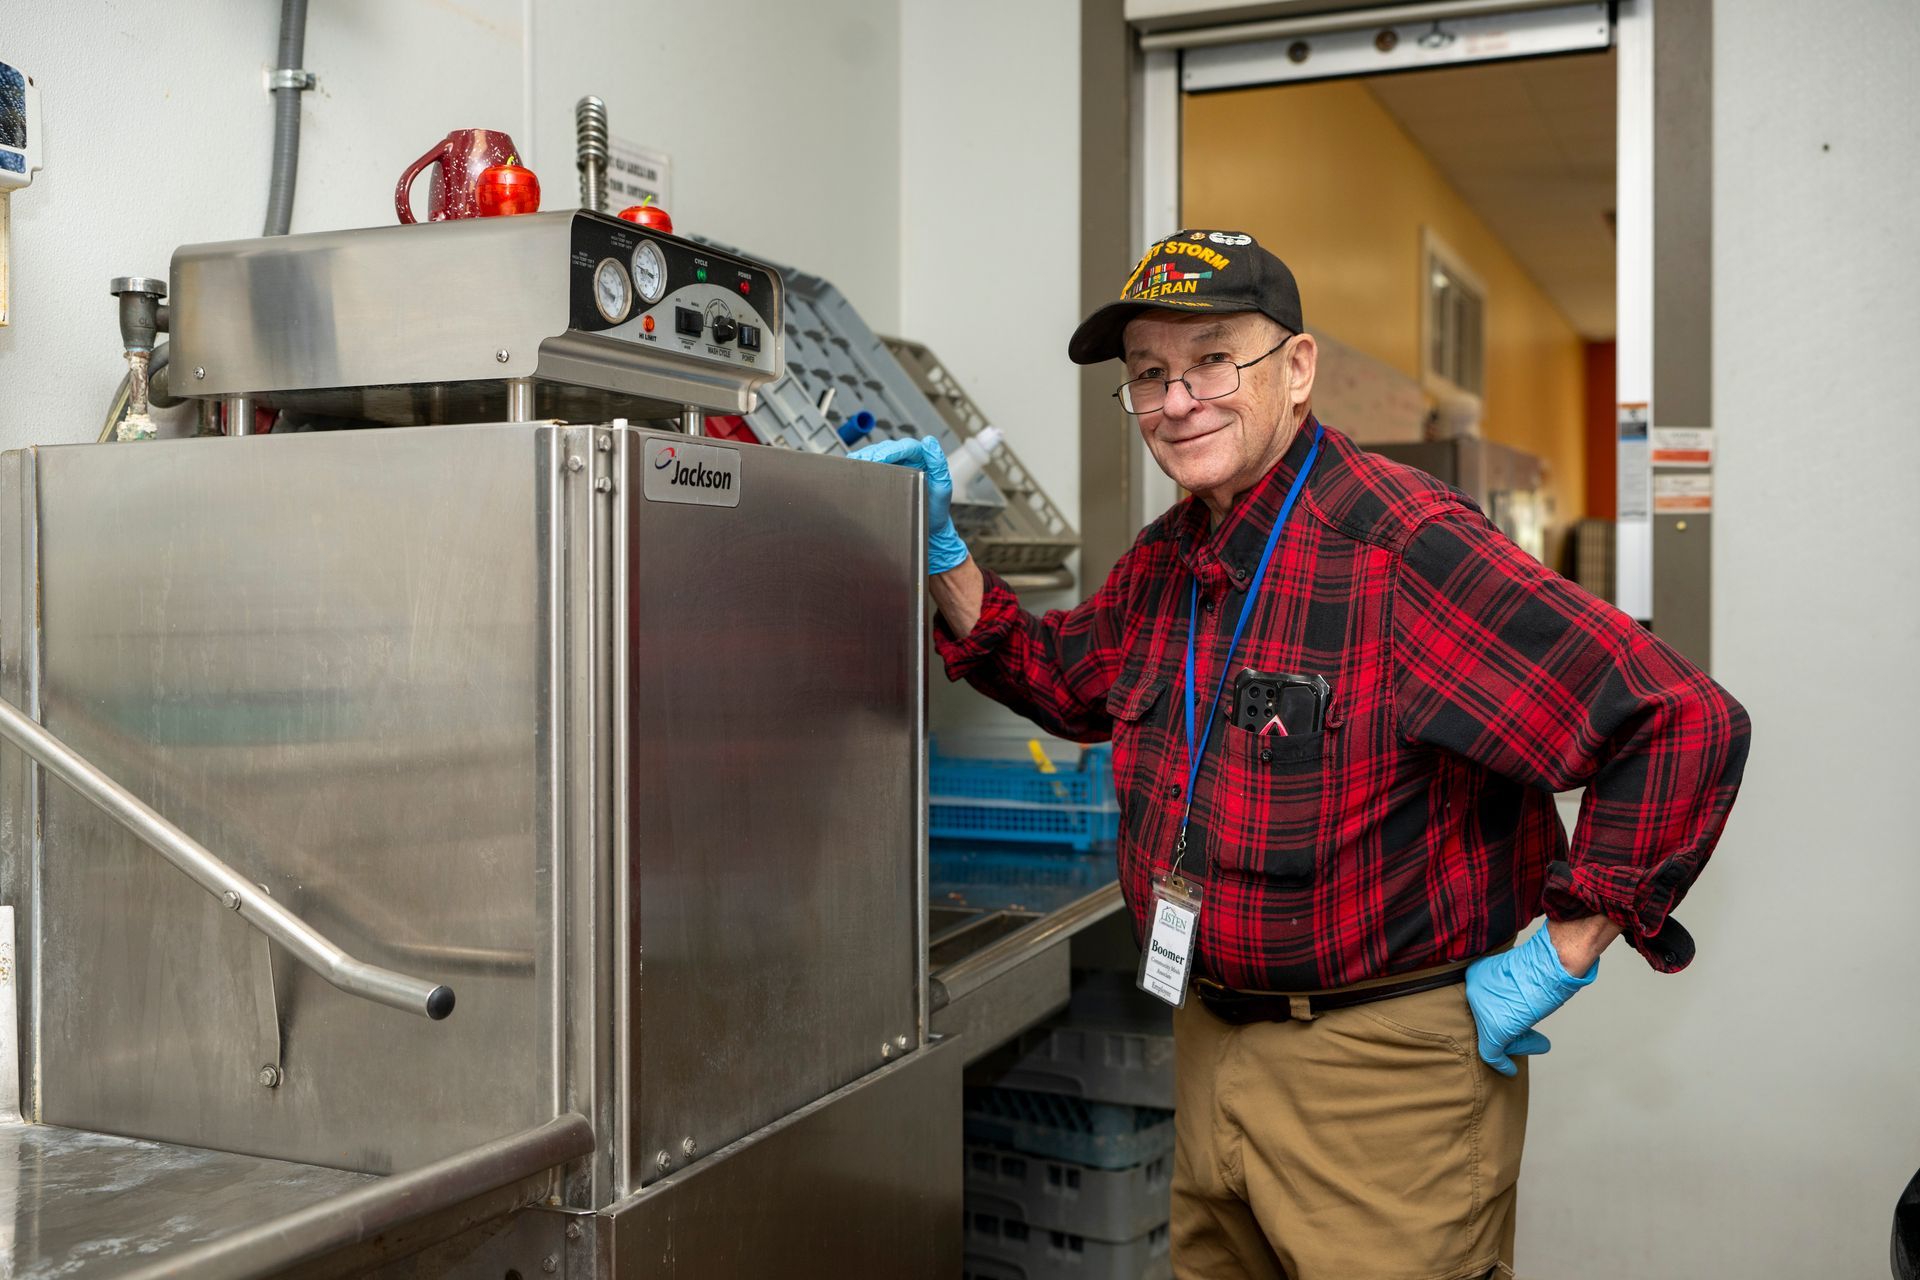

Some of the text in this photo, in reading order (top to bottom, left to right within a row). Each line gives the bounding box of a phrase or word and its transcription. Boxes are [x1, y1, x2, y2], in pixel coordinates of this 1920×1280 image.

[694, 257, 708, 267] CYCLE
[1164, 241, 1231, 271] STORM
[738, 271, 752, 280] POWER
[1133, 280, 1198, 300] TERAN
[639, 332, 657, 342] HI LIMIT
[707, 346, 731, 359] WASH CYCLE
[742, 353, 755, 363] POWER
[671, 460, 732, 490] Jackson
[1160, 909, 1187, 930] LISTEN
[1151, 938, 1185, 965] Boomer
